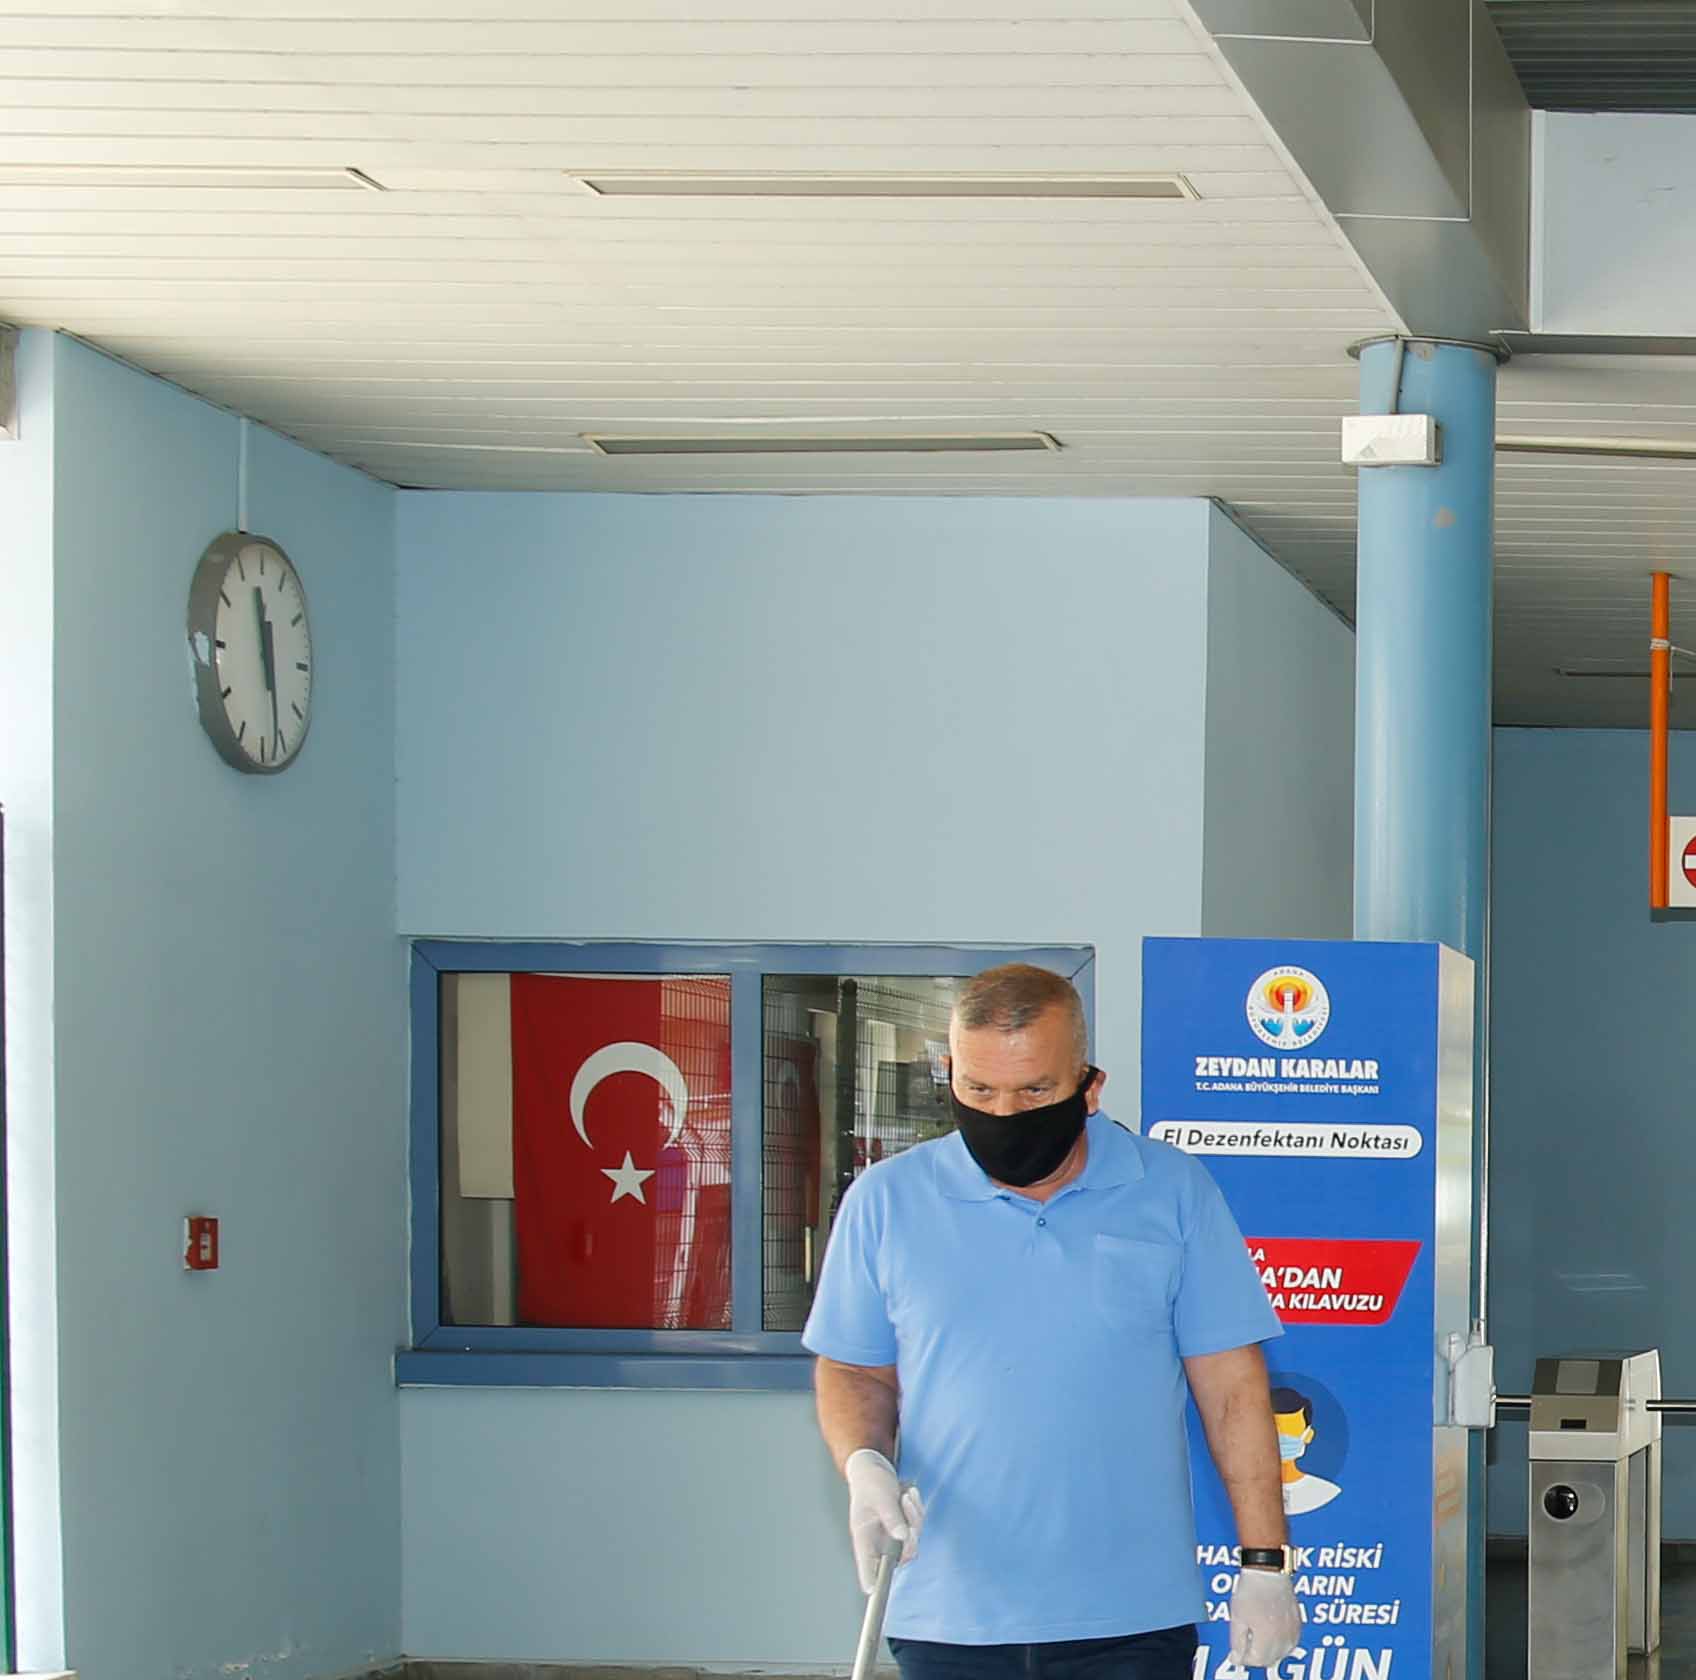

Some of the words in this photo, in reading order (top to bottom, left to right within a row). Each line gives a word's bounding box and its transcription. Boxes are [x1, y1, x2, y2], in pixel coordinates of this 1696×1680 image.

[1195, 1056, 1276, 1077] ZEYDAN
[1280, 1058, 1379, 1079] KARALAR
[1212, 1082, 1244, 1092] ADANA
[1164, 1128, 1181, 1145] El
[1187, 1129, 1324, 1148] Dezenfektanı
[1330, 1132, 1409, 1150] Noktası
[1289, 1293, 1384, 1311] KILAVUZU
[1318, 1543, 1384, 1569] RİSKİ
[1313, 1599, 1401, 1625] SÜRESİ
